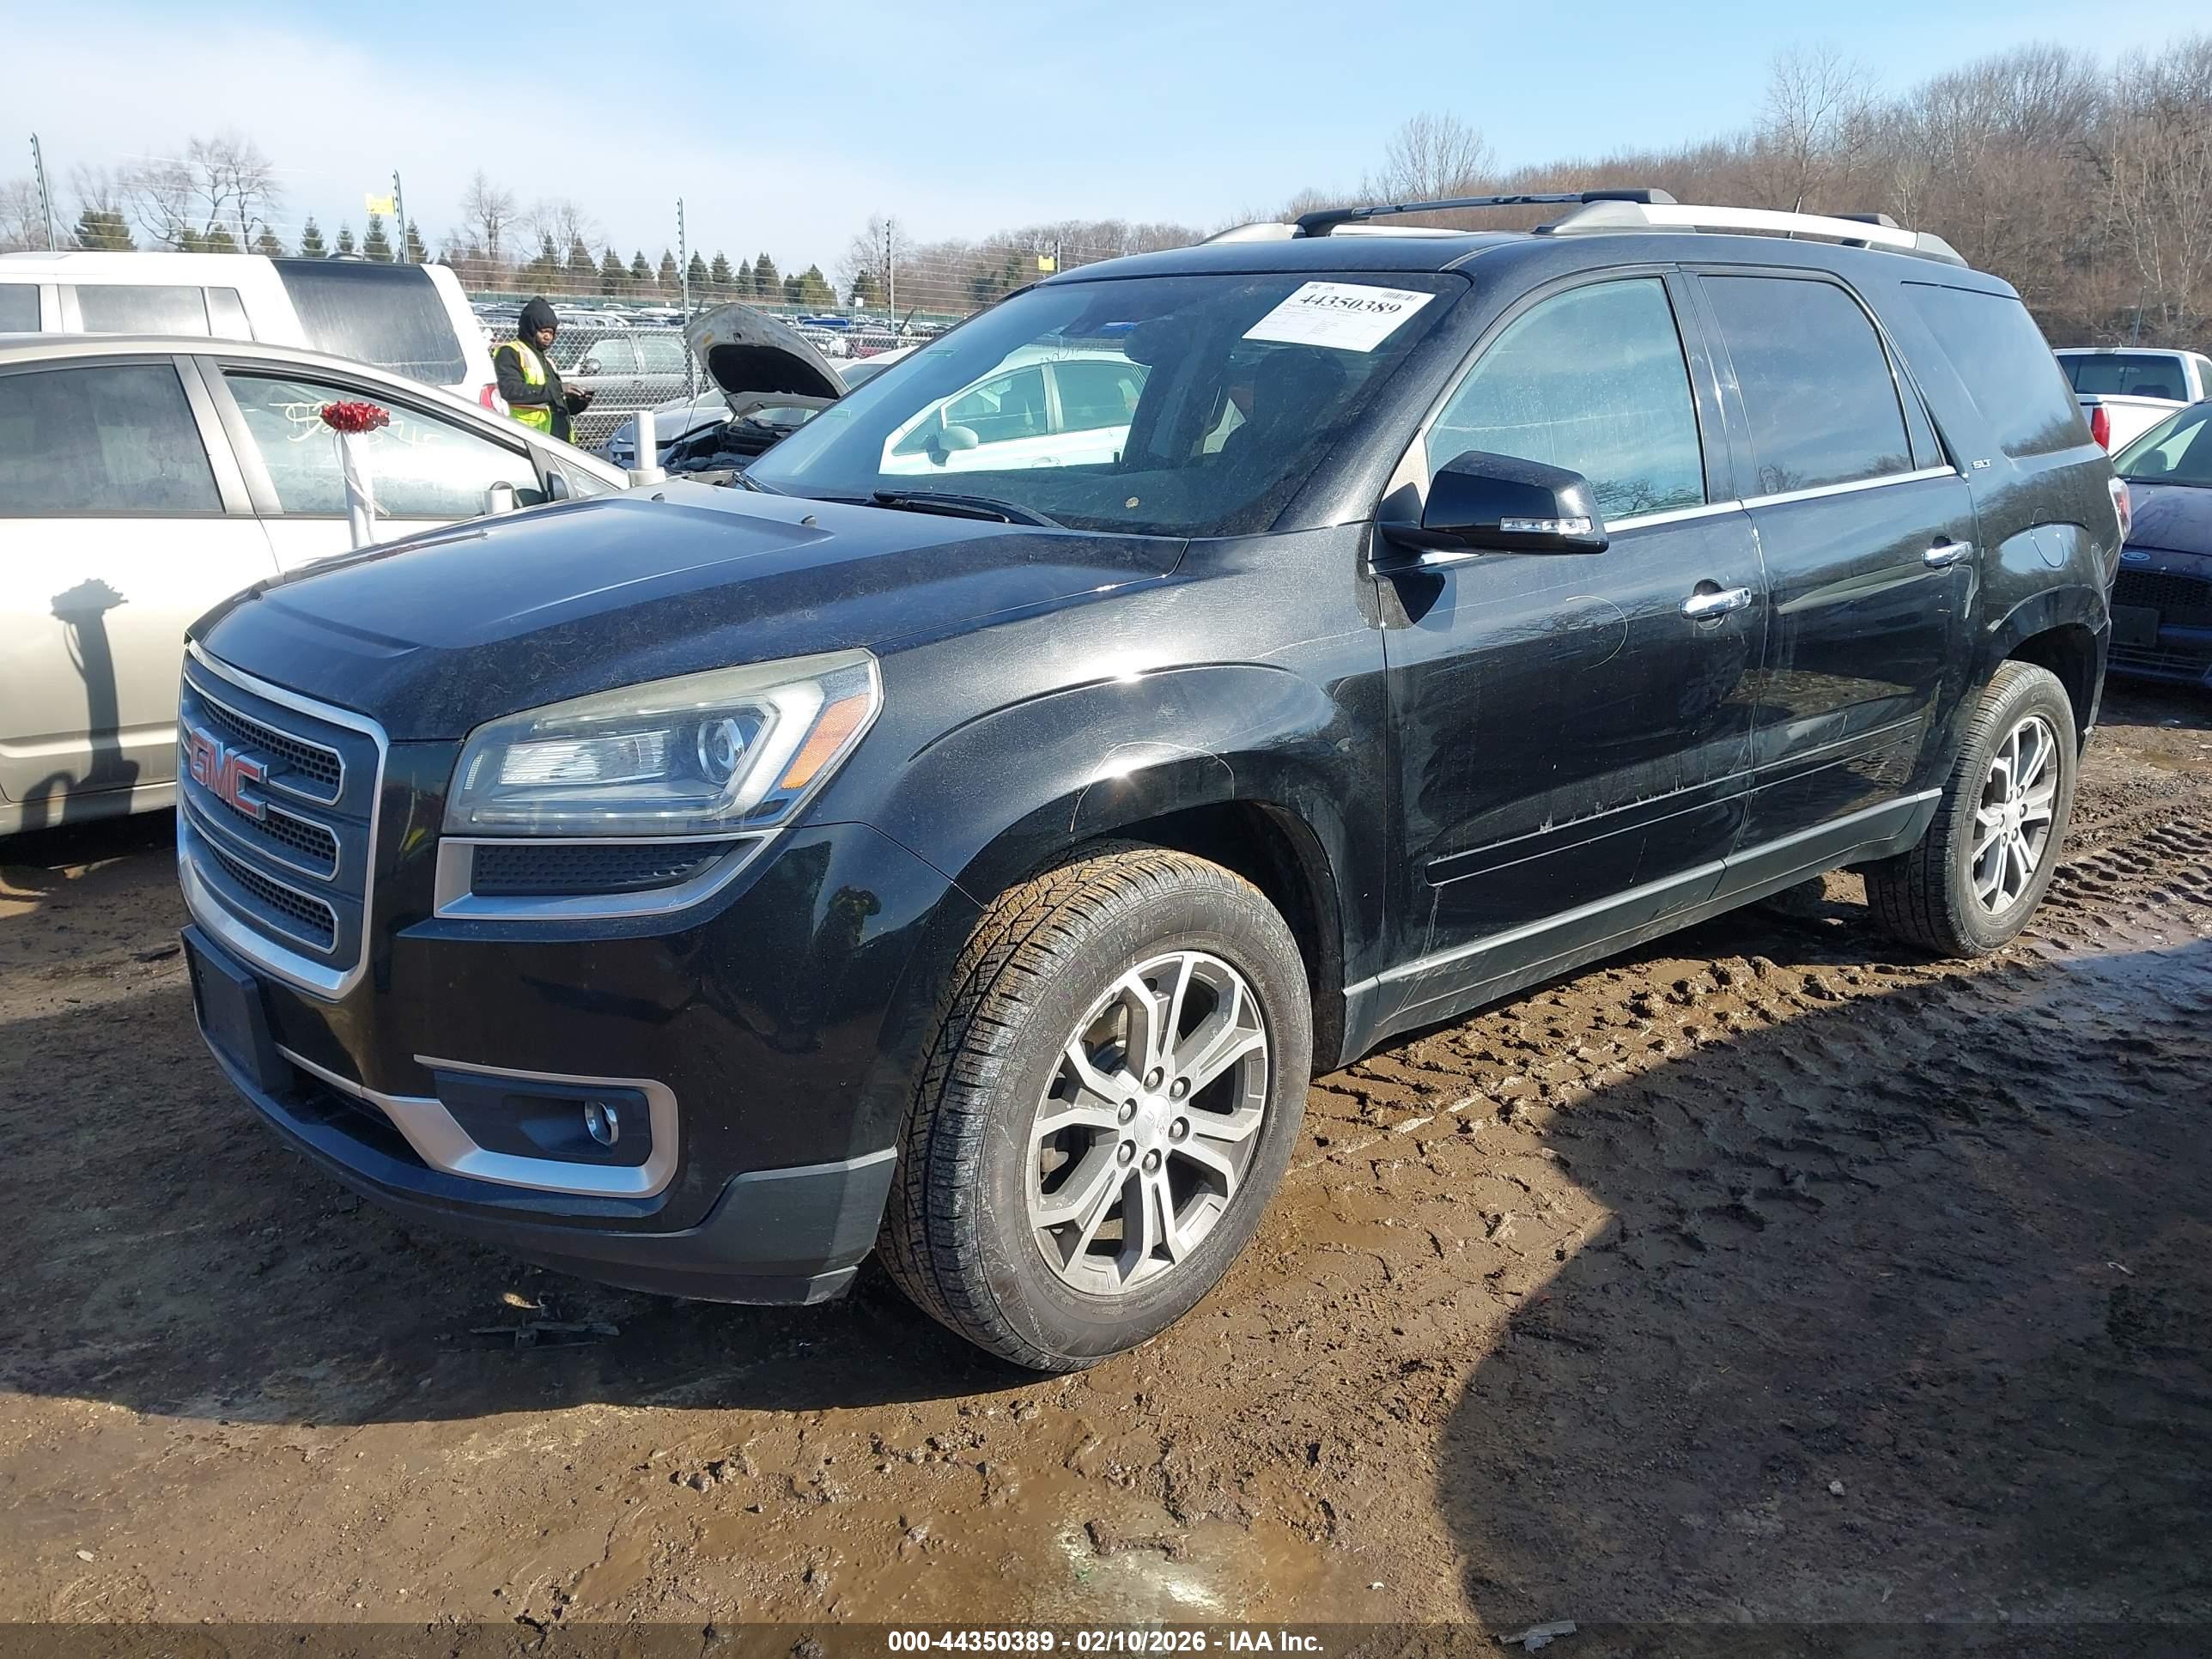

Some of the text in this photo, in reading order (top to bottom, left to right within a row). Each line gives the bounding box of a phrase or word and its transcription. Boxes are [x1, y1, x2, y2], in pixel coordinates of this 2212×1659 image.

[1299, 293, 1401, 314] 44350389
[1972, 459, 1992, 469] SLT
[191, 726, 267, 821] GMC
